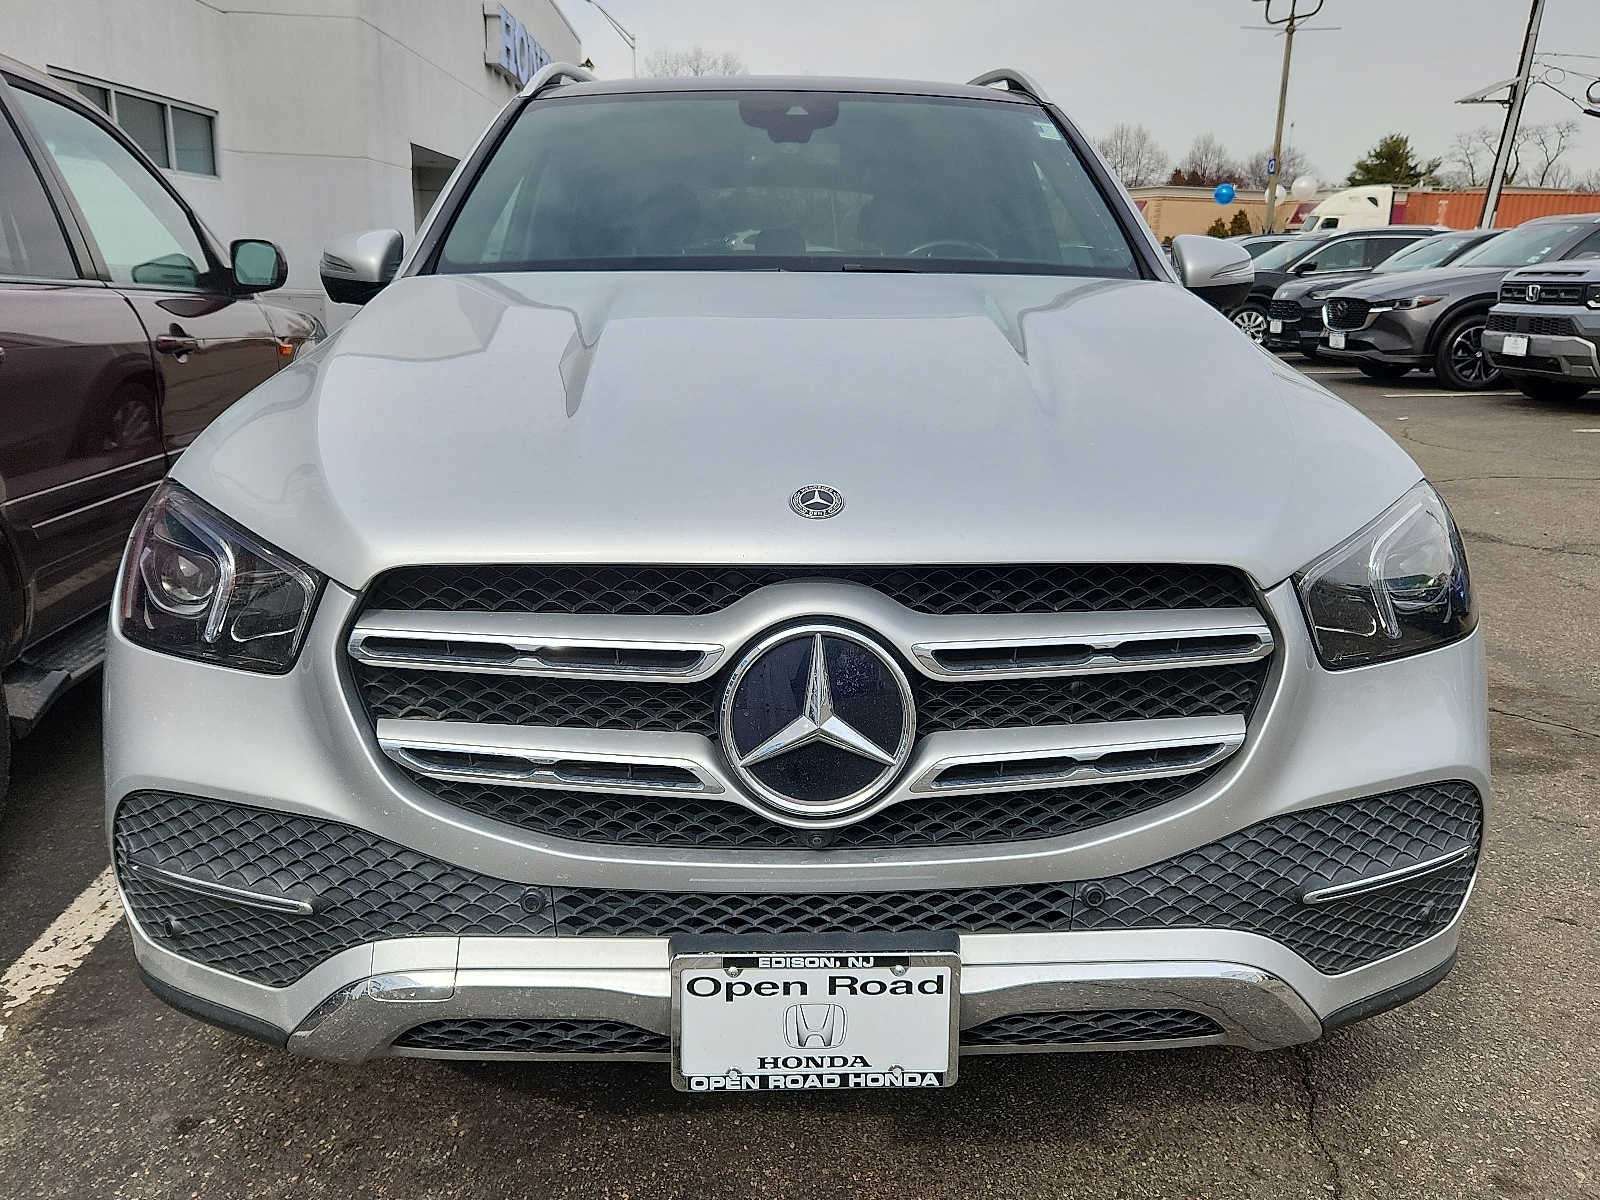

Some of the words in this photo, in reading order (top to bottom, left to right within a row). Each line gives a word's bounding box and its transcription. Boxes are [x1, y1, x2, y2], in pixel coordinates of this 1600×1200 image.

[758, 957, 841, 969] EDISON,
[848, 956, 875, 967] NJ
[686, 976, 808, 1003] Open
[828, 974, 944, 996] Road
[757, 1055, 872, 1070] HONDA
[690, 1075, 760, 1091] OPEN
[769, 1073, 841, 1089] ROAD
[849, 1071, 940, 1088] HONDA
